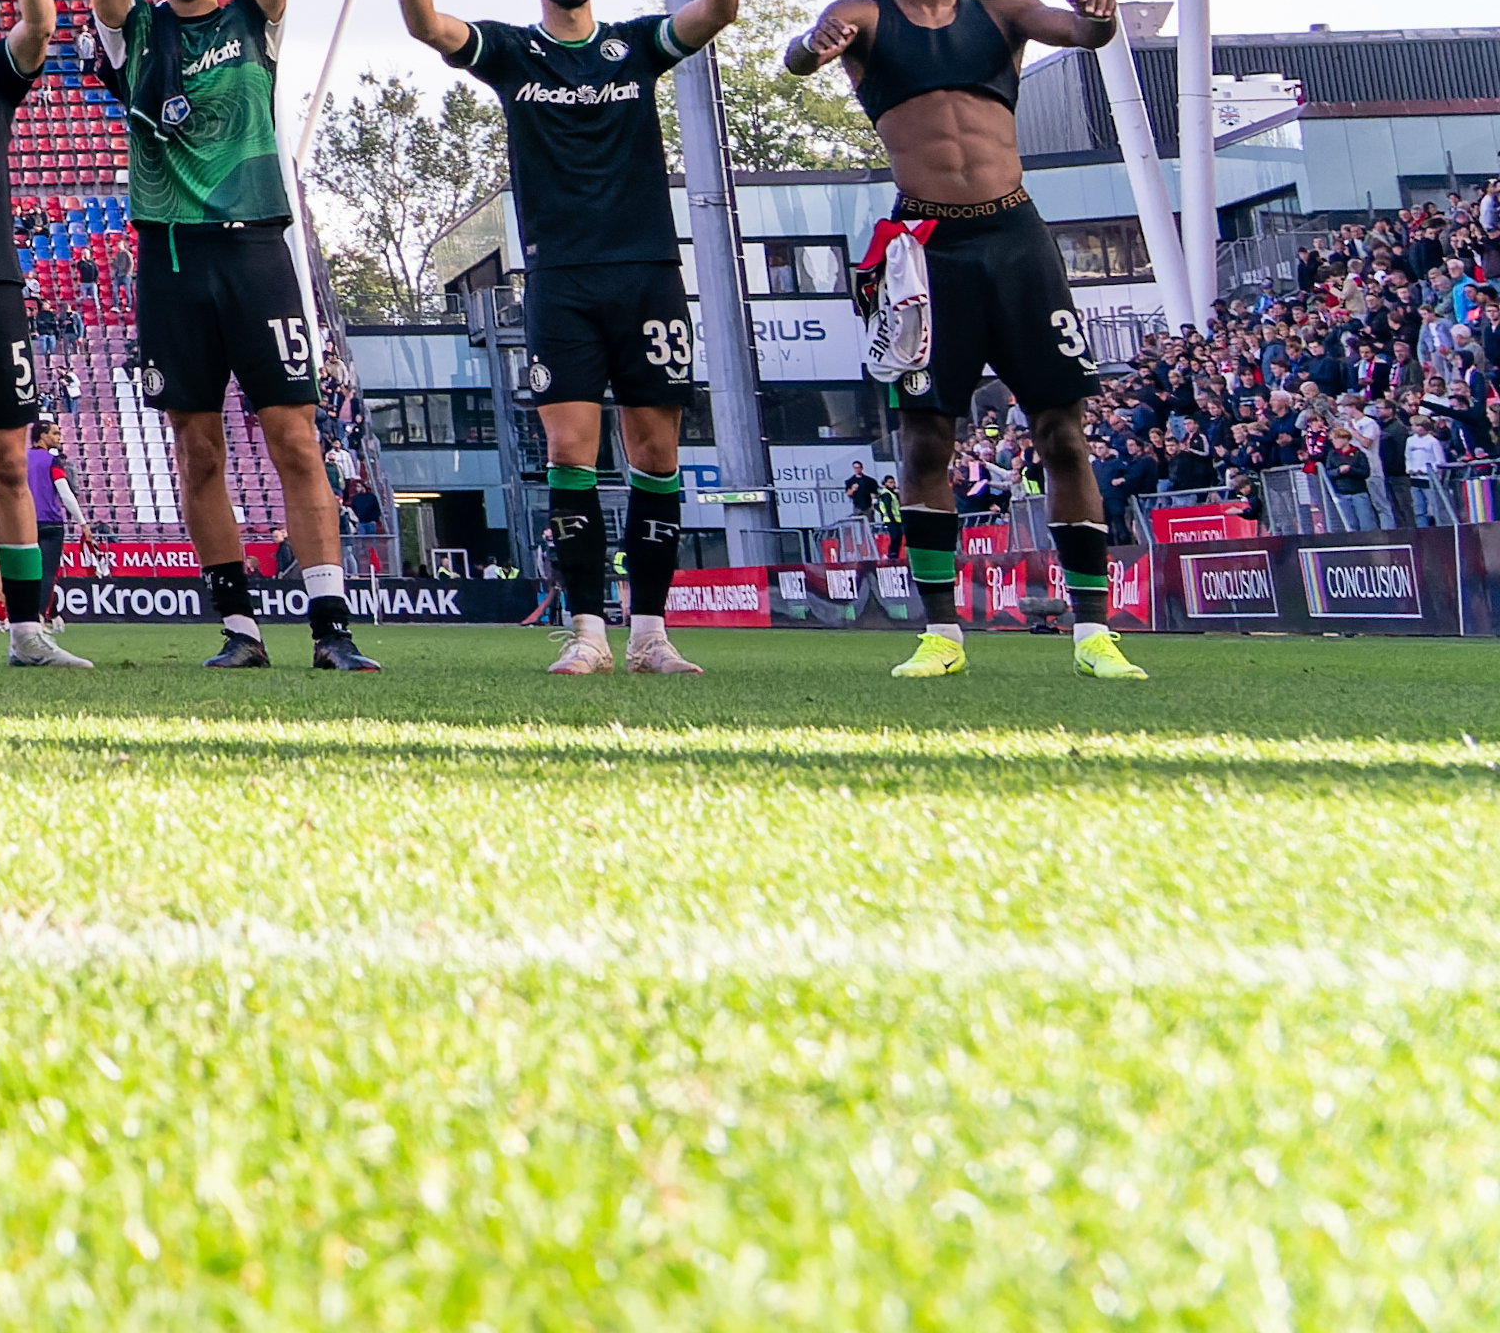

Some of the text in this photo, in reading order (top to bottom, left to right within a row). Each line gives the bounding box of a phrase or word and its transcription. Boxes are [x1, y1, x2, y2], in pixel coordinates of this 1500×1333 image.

[901, 197, 996, 219] FEYENOORD
[267, 317, 310, 362] 15
[642, 319, 692, 366] 33
[11, 340, 32, 387] 5
[121, 552, 199, 568] MAAREL
[92, 582, 200, 616] Kroon
[779, 570, 808, 600] UNIBET
[826, 568, 858, 600] UNIBET
[876, 566, 911, 598] UNIBET
[986, 565, 1017, 612] Bud
[1107, 559, 1140, 610] Bud
[1202, 568, 1270, 601] CONCLUSION
[1326, 564, 1414, 600] CONCLUSION
